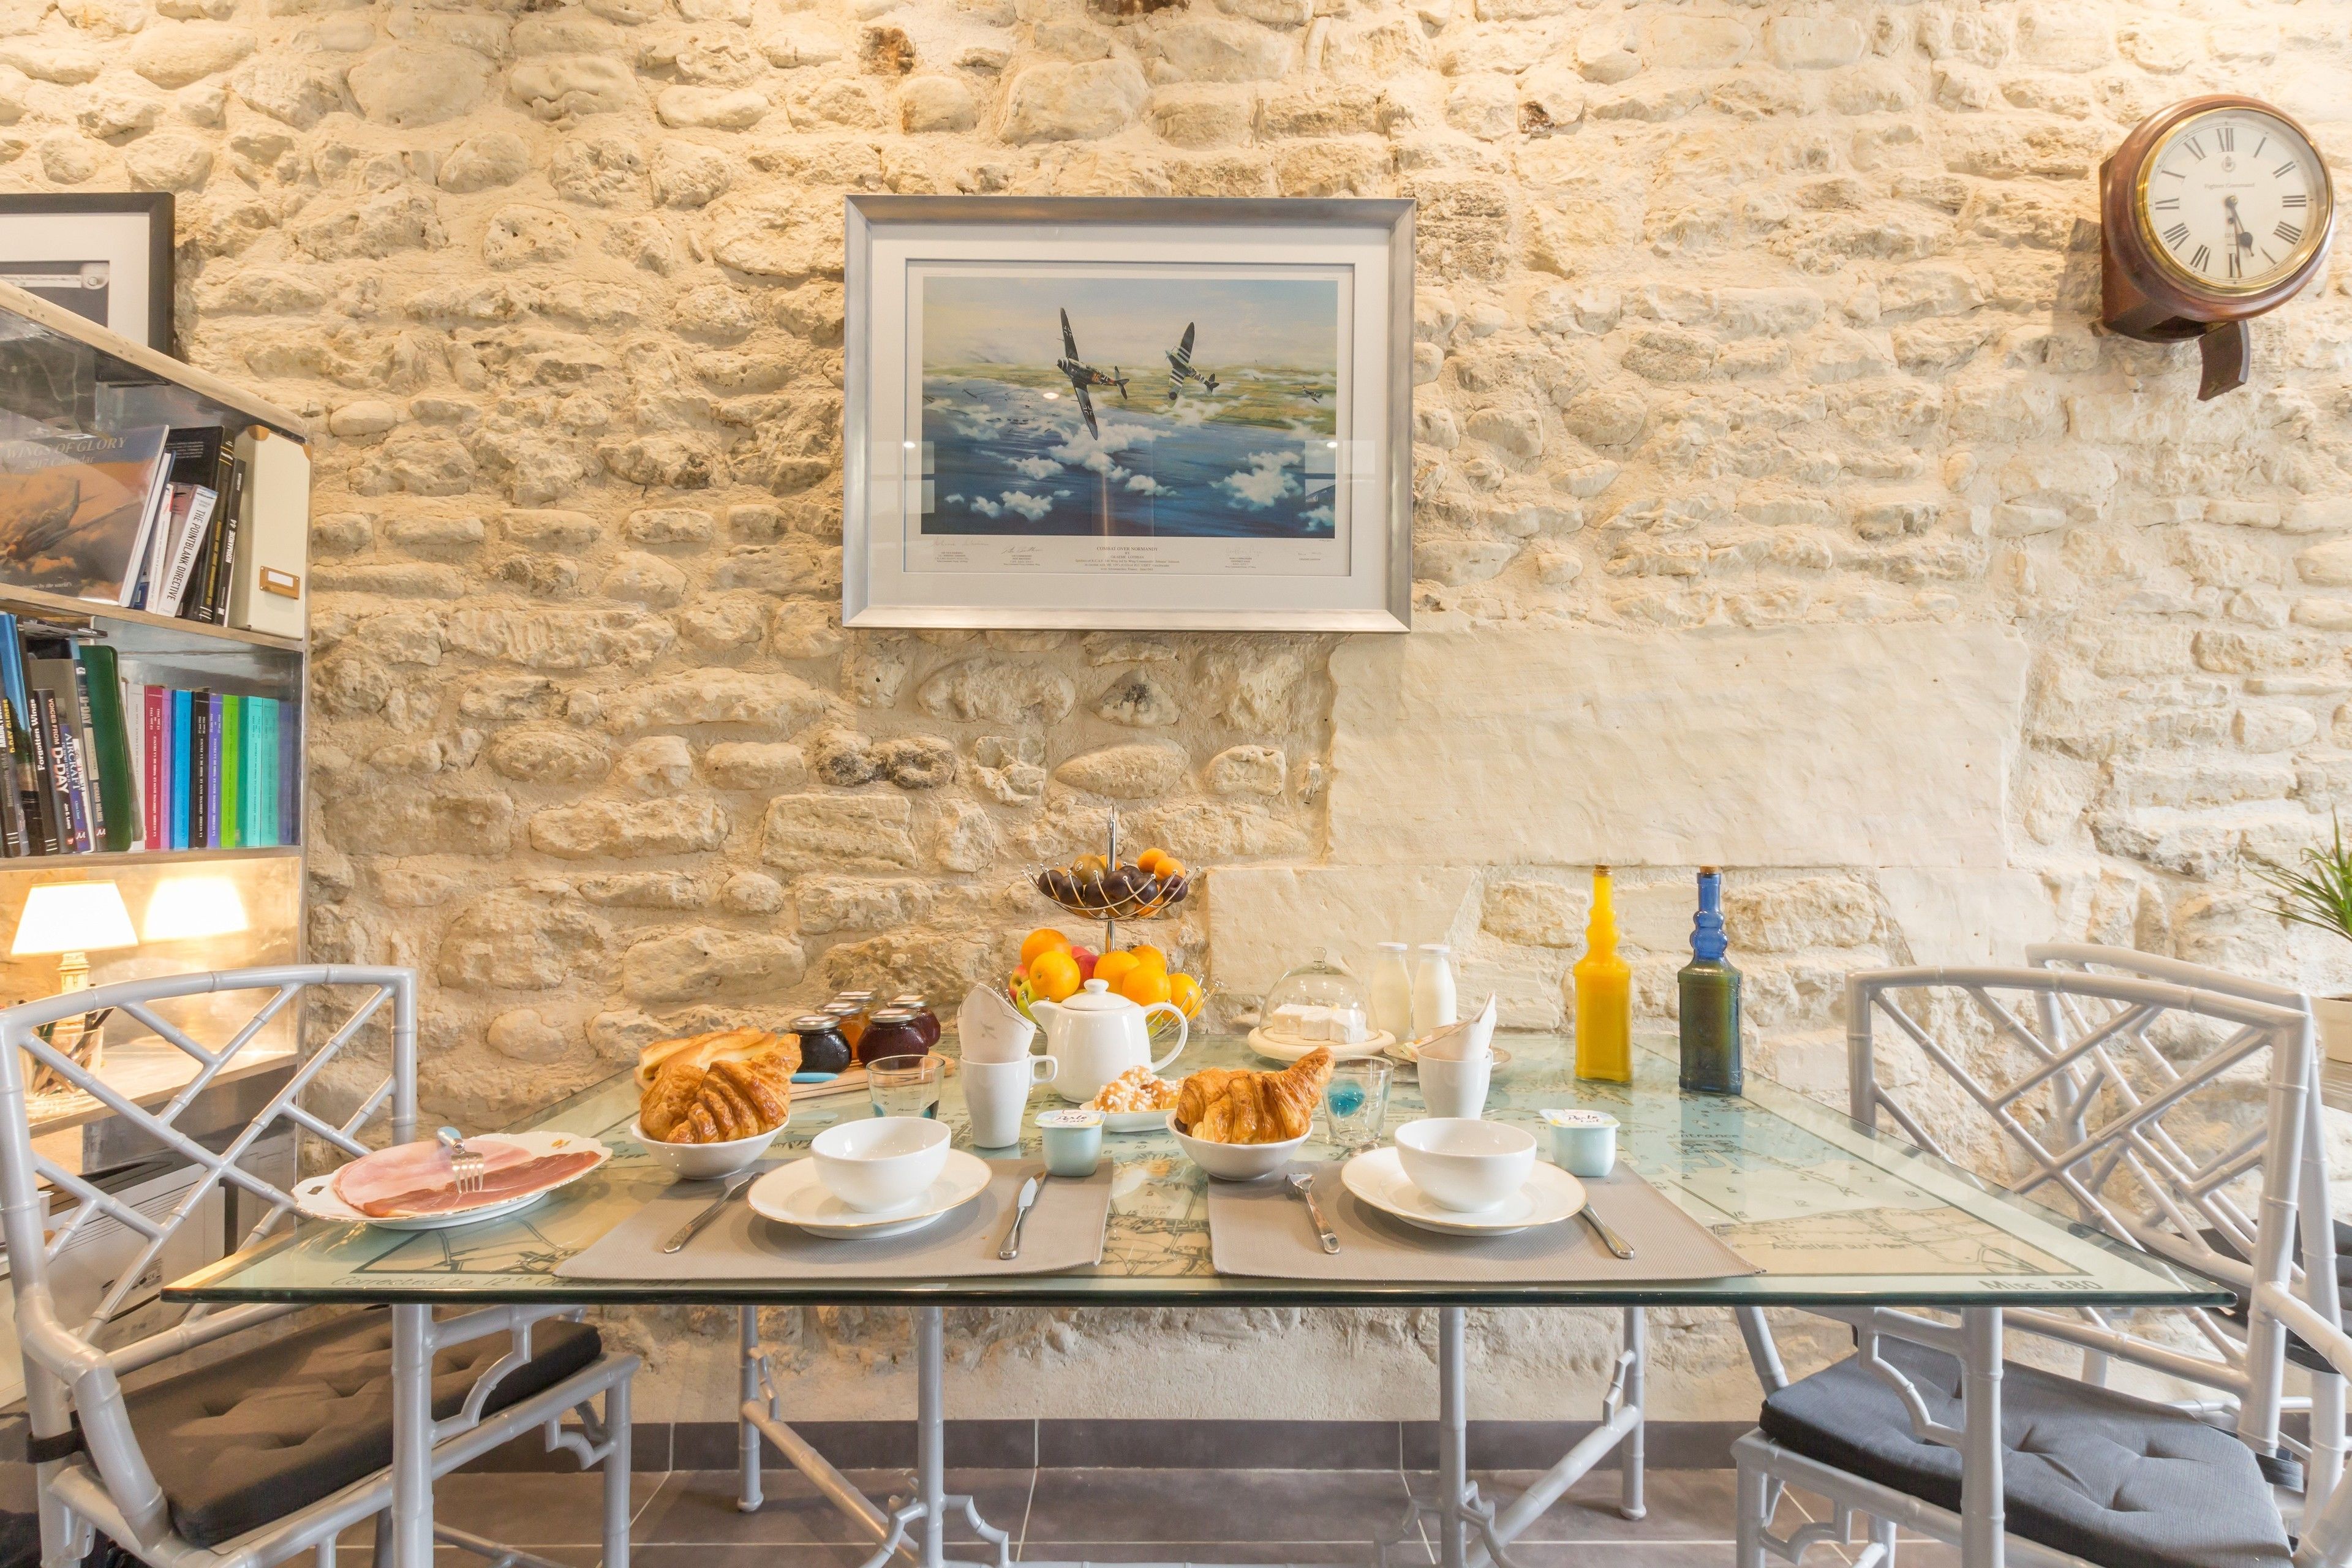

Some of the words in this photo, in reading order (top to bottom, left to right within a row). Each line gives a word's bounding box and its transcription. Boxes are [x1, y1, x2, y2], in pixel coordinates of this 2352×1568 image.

[56, 442, 76, 454] OF
[77, 437, 127, 453] GLORY
[193, 509, 206, 521] THE
[179, 522, 201, 566] POINTBLANK
[225, 530, 236, 564] NORMANDIE
[231, 519, 237, 529] 44
[167, 566, 185, 601] DIRECTIVE
[30, 698, 39, 727] Wings
[48, 698, 57, 724] VOICES
[34, 728, 45, 771] Forgotten
[51, 726, 60, 745] FROM
[51, 747, 70, 794] D-DAY
[64, 733, 81, 791] AIRCRAFT
[331, 1276, 441, 1287] Corrected
[448, 1277, 472, 1286] to
[1978, 1280, 2049, 1290] Misc.
[2051, 1280, 2104, 1290] 880
